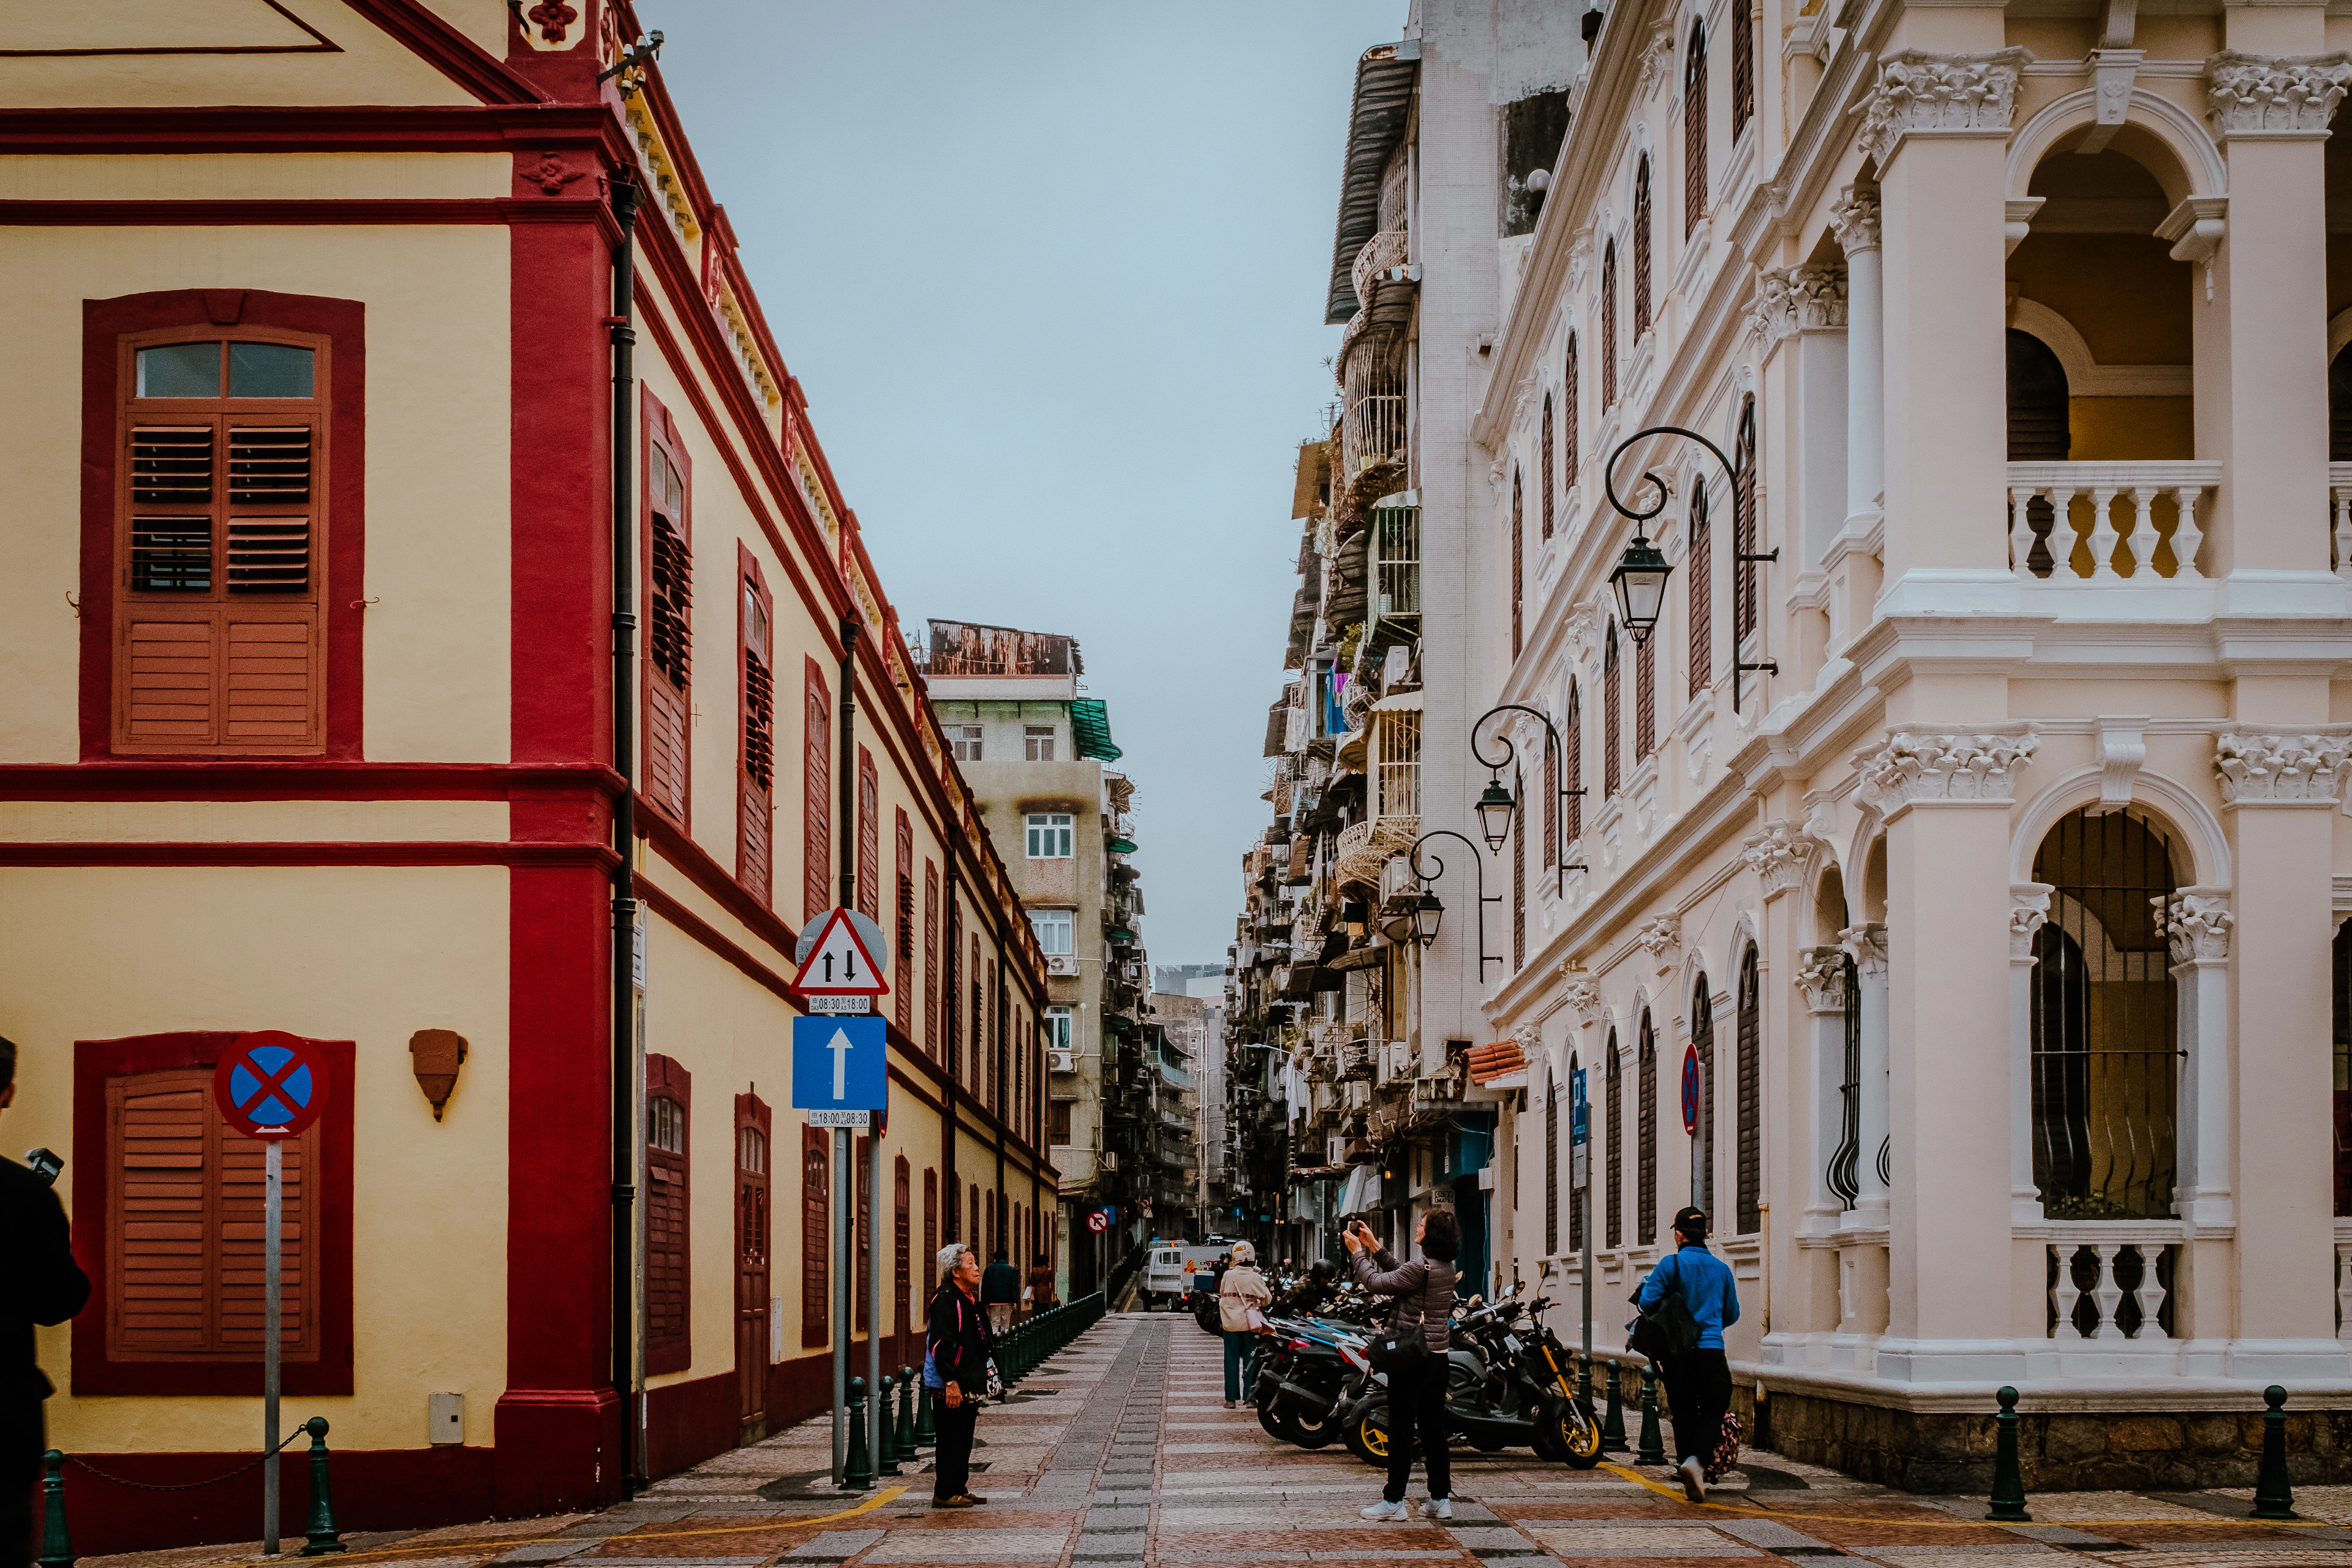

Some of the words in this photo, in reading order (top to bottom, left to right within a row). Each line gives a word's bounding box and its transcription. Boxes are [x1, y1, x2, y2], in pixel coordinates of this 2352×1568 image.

[819, 998, 840, 1009] 08:30
[847, 998, 867, 1009] 18:00
[819, 1112, 840, 1124] 18:00
[846, 1112, 867, 1124] 08:30
